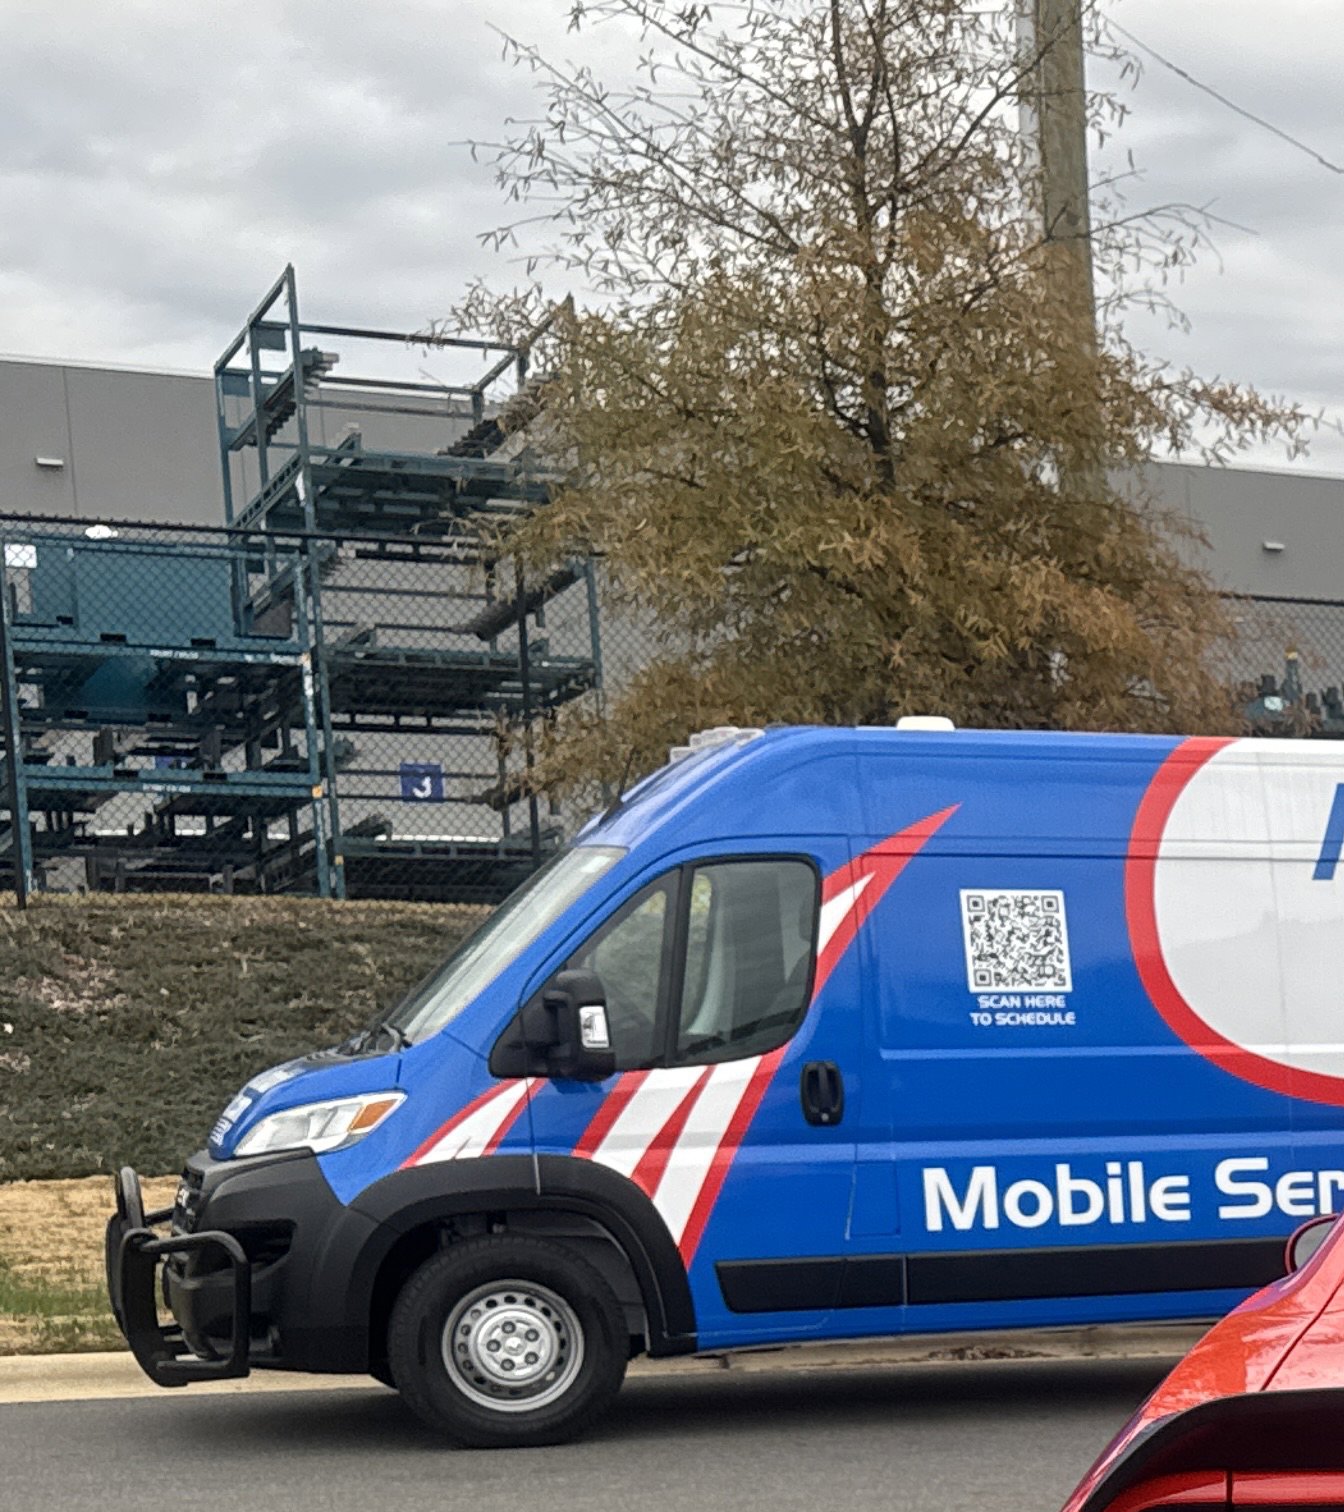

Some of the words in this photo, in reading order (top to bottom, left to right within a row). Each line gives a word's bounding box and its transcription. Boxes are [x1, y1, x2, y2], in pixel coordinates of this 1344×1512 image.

[978, 995, 1021, 1008] SCAN
[1024, 995, 1066, 1008] HERE
[969, 1012, 992, 1026] TO
[995, 1012, 1076, 1025] SCHEDULE
[922, 1161, 1192, 1232] Mobile
